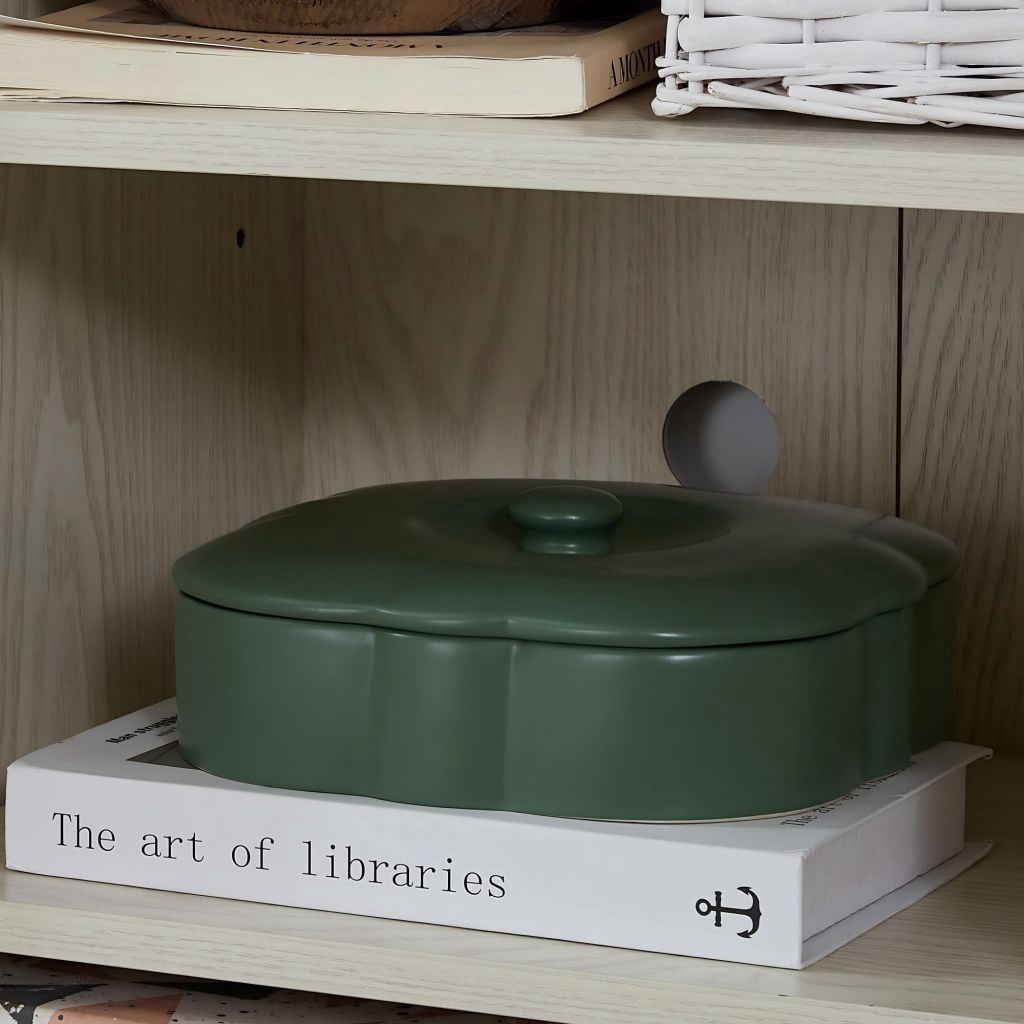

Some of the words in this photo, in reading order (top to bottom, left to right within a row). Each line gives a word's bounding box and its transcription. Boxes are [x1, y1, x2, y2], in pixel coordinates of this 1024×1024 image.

[608, 59, 618, 90] A
[52, 812, 116, 852] The
[141, 831, 205, 863] art
[231, 837, 275, 871] of
[302, 840, 506, 899] libraries
